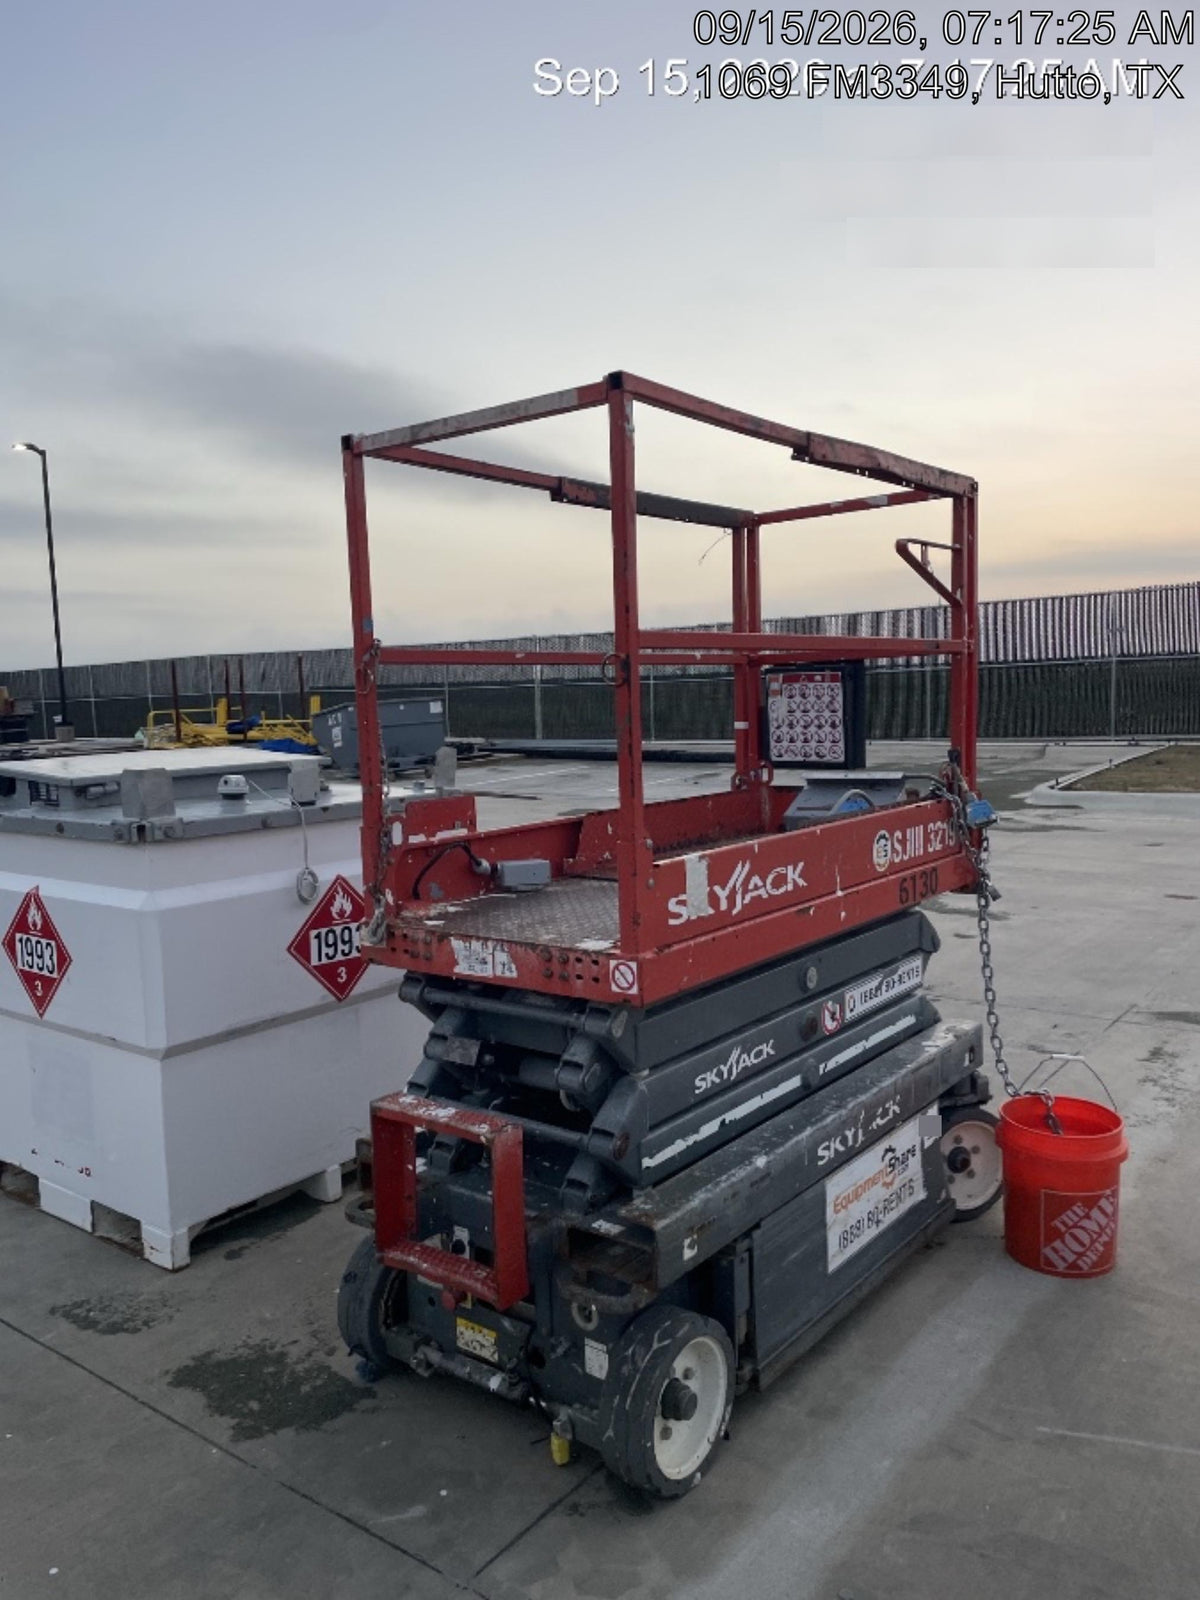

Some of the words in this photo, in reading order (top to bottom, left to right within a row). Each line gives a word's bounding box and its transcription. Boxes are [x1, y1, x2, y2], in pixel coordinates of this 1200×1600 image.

[667, 860, 808, 926] SYJACK
[899, 867, 938, 905] 6130
[18, 936, 56, 974] 1993
[34, 980, 43, 997] 3
[336, 966, 347, 983] 3
[694, 1039, 776, 1095] SKYJACK
